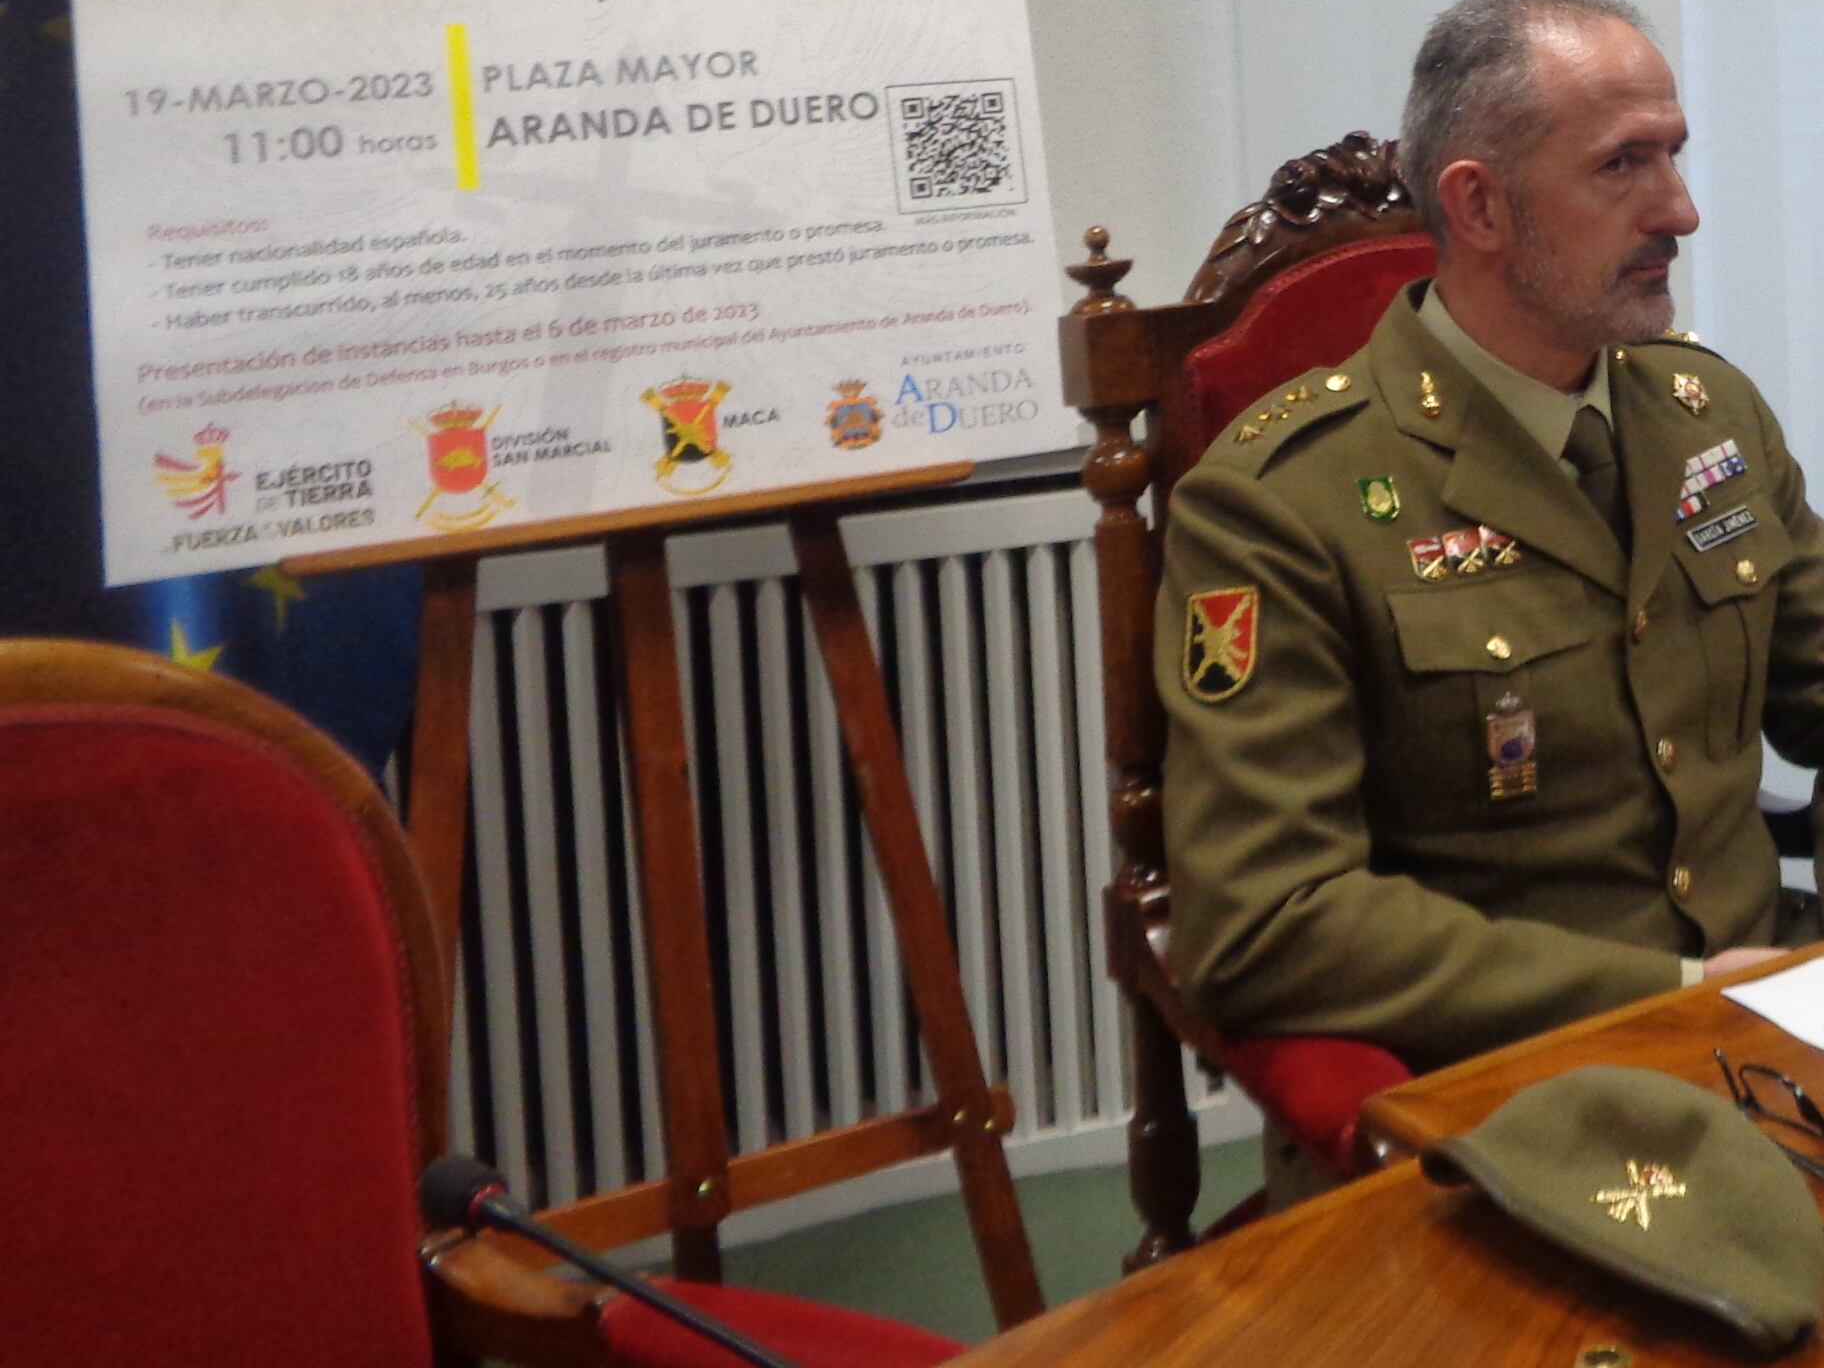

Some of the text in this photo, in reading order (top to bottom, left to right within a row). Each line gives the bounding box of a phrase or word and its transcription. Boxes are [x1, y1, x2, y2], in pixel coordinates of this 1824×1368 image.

[482, 50, 758, 93] PLAZA MAYOR
[124, 72, 434, 116] 19-MARZO-2023
[486, 91, 879, 148] ARANDA DE DUERO
[223, 124, 437, 164] 11:00 horas
[163, 227, 467, 269] Tener nacionalidad española.
[164, 282, 225, 299] Tener
[230, 270, 331, 294] cumplido
[365, 262, 414, 282] años
[419, 258, 445, 275] de
[450, 252, 499, 272] edad
[506, 252, 530, 266] en
[536, 248, 551, 264] el
[557, 240, 650, 261] momento
[656, 236, 684, 253] del
[688, 228, 784, 254] juramento
[789, 227, 801, 240] o
[166, 232, 1034, 331] Haber transcurrido, al menos, 25 años desde la última vez que prestó juramento o promesa.
[137, 349, 297, 384] Presentación
[302, 345, 333, 366] de
[455, 328, 517, 350] hasta
[522, 323, 542, 342] el
[548, 318, 562, 339] 6
[568, 316, 598, 337] de
[603, 311, 676, 333] marzo
[682, 306, 709, 324] de
[713, 302, 761, 322] 2023
[338, 373, 361, 391] de
[366, 367, 438, 388] Defensa
[442, 364, 465, 378] en
[469, 357, 529, 377] Burgos
[880, 315, 898, 328] de
[902, 309, 954, 326] Aranda
[958, 305, 976, 319] de
[901, 343, 1025, 367] AYUNTAMIENTO
[894, 368, 1036, 405] ARANDA
[722, 409, 780, 429] MACA
[891, 399, 1038, 433] de DUERO
[492, 427, 569, 450] DIVISIÓN
[493, 440, 612, 467] SAN MARCIAL
[256, 458, 373, 491] EJÉRCITO
[284, 481, 373, 508] TIERRA
[172, 524, 258, 553] FUERZA
[277, 508, 375, 537] VALORES
